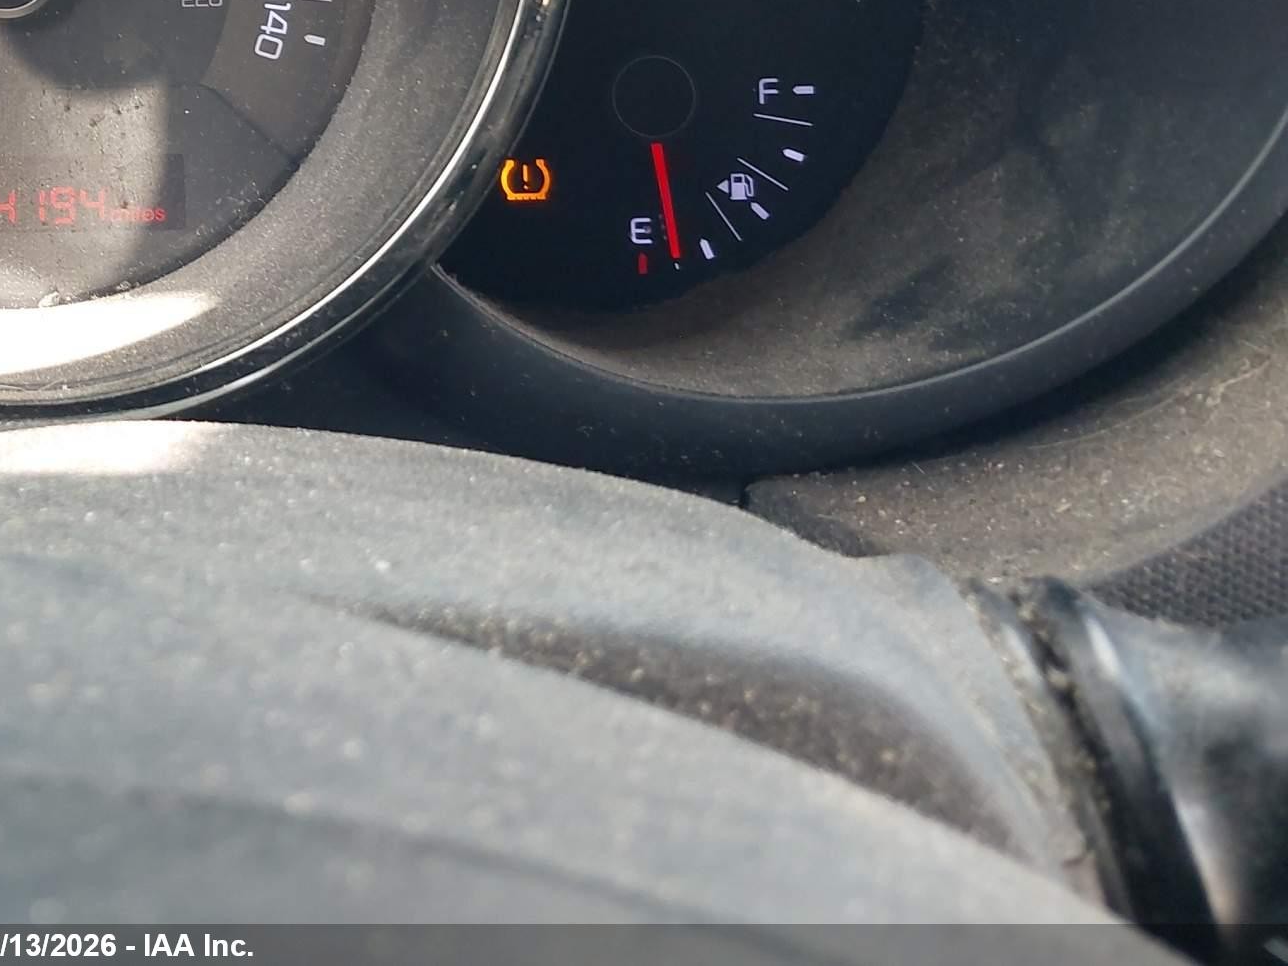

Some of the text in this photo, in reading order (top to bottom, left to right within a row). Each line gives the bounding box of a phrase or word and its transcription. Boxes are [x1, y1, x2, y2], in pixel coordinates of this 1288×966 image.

[254, 2, 292, 60] 140
[758, 78, 780, 104] F
[630, 217, 653, 244] E
